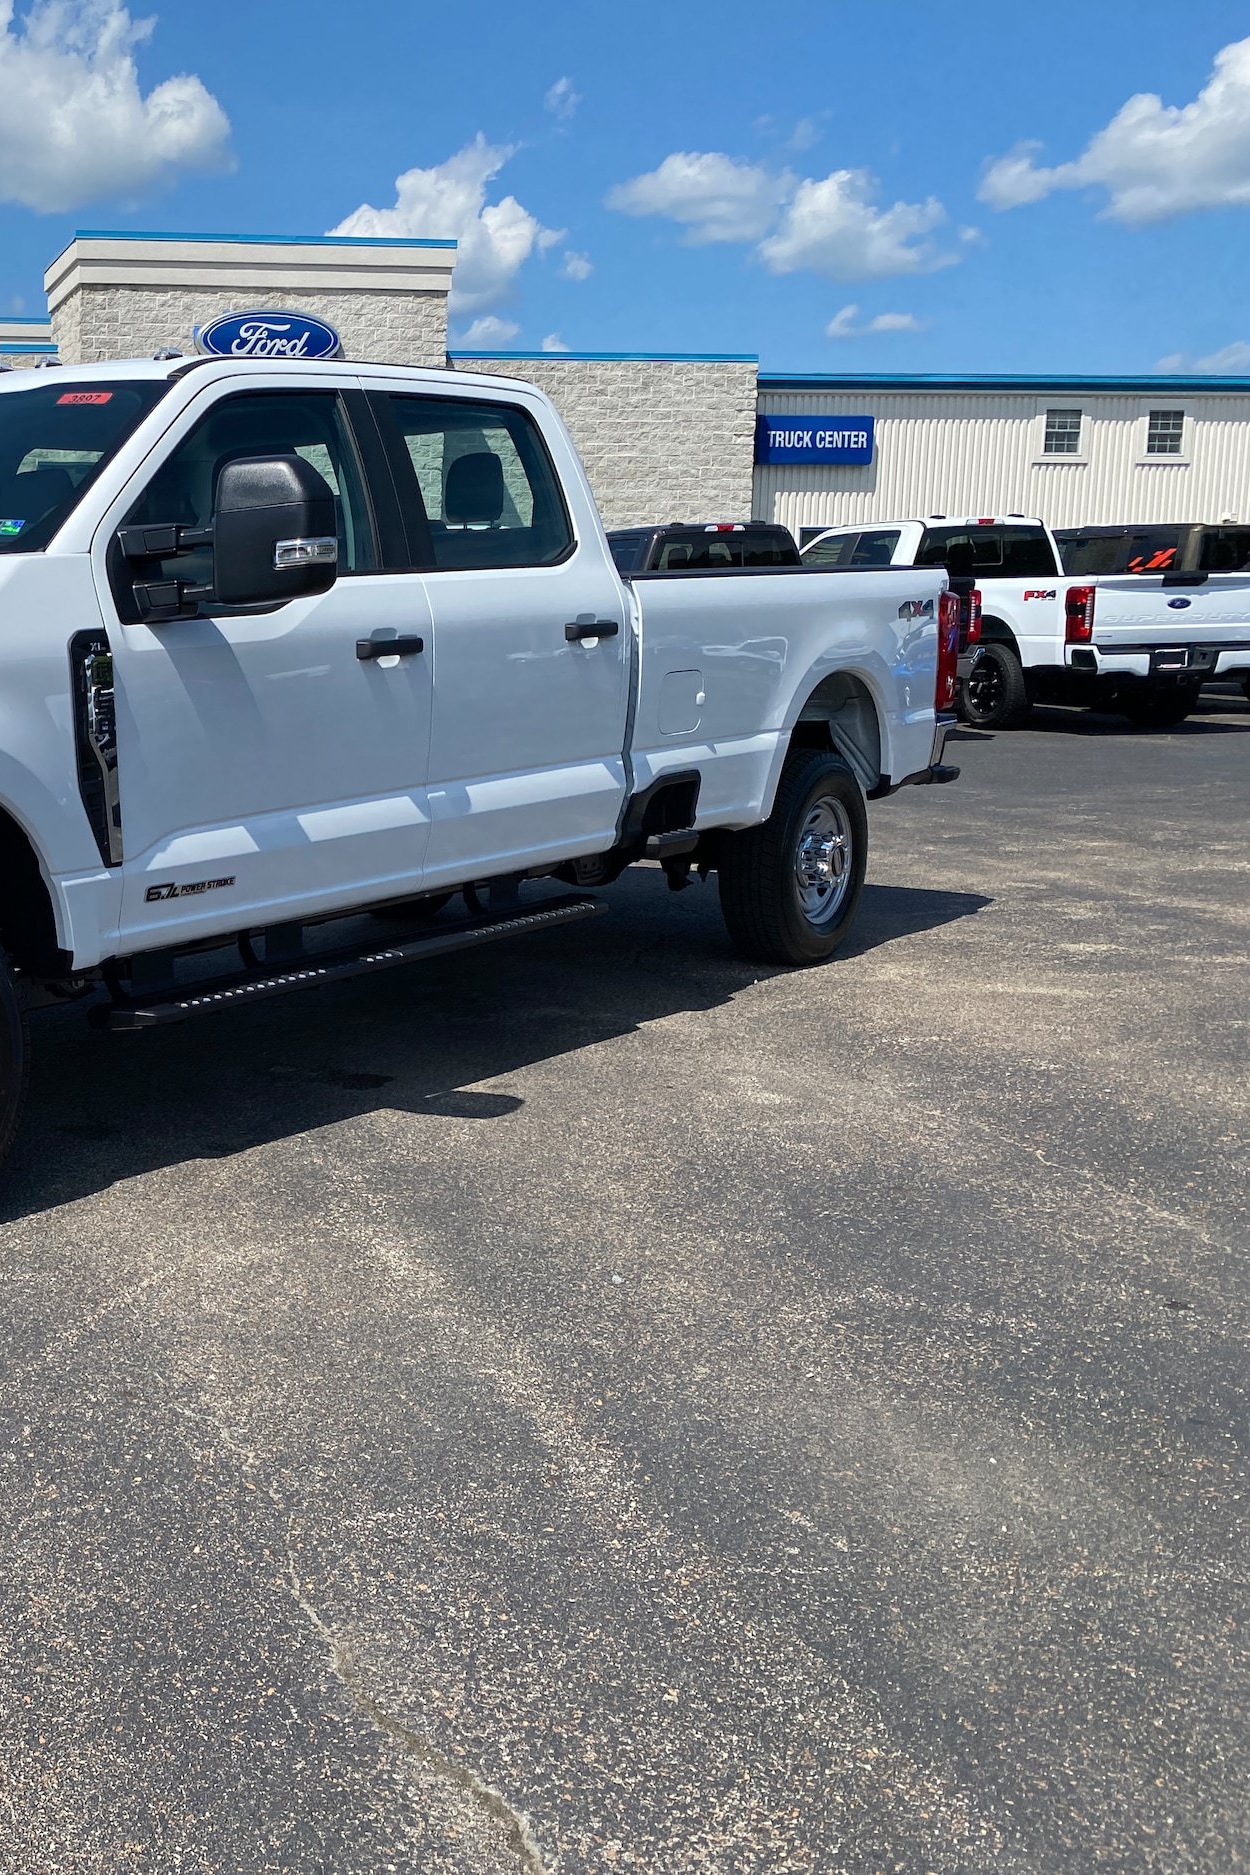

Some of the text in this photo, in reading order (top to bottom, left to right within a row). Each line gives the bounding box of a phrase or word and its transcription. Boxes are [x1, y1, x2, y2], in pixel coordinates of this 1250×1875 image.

[231, 322, 310, 356] Ford
[67, 394, 102, 403] 3897
[767, 430, 868, 449] TRUCK CENTER
[1024, 590, 1056, 601] FX4
[1104, 611, 1250, 623] SUPER DUTY
[180, 881, 206, 893] POWER
[206, 876, 236, 889] STROKE
